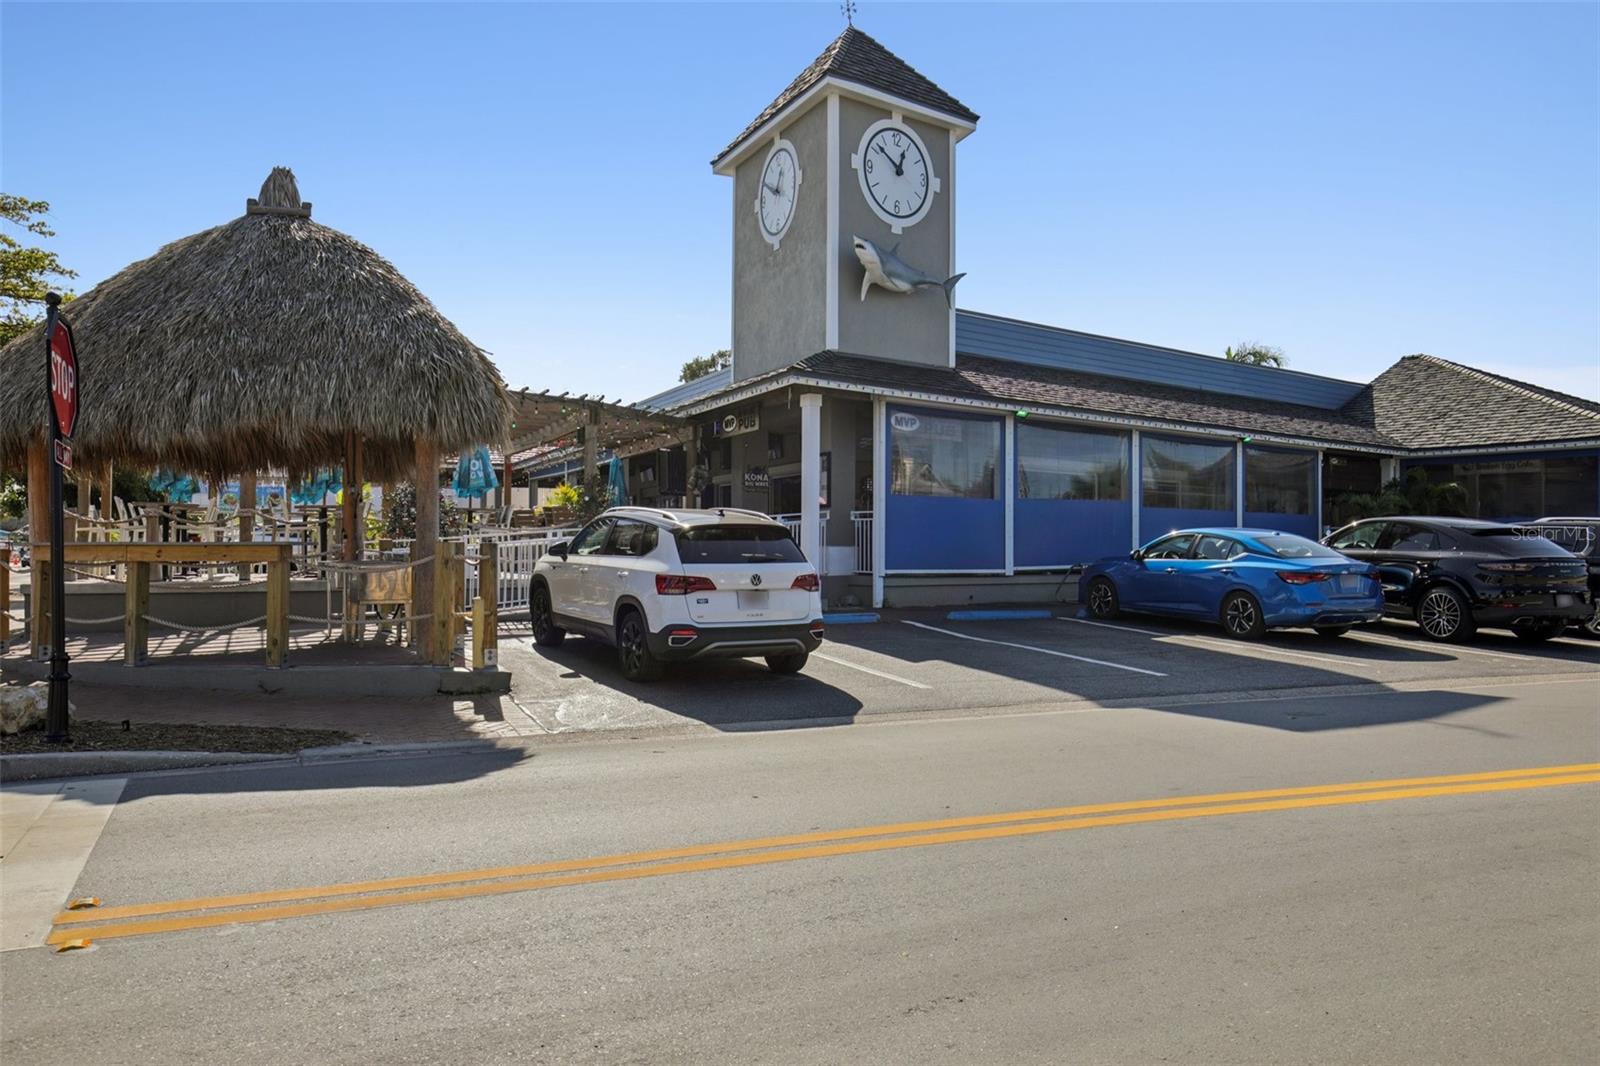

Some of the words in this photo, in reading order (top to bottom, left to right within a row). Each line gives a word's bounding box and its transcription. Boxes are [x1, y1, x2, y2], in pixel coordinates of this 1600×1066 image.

[891, 133, 901, 147] 12
[866, 160, 873, 174] 9
[920, 173, 926, 188] 3
[894, 200, 900, 214] 6
[51, 350, 74, 403] STOP
[738, 415, 756, 431] PUB
[894, 415, 917, 429] MVP
[744, 473, 769, 482] KONA
